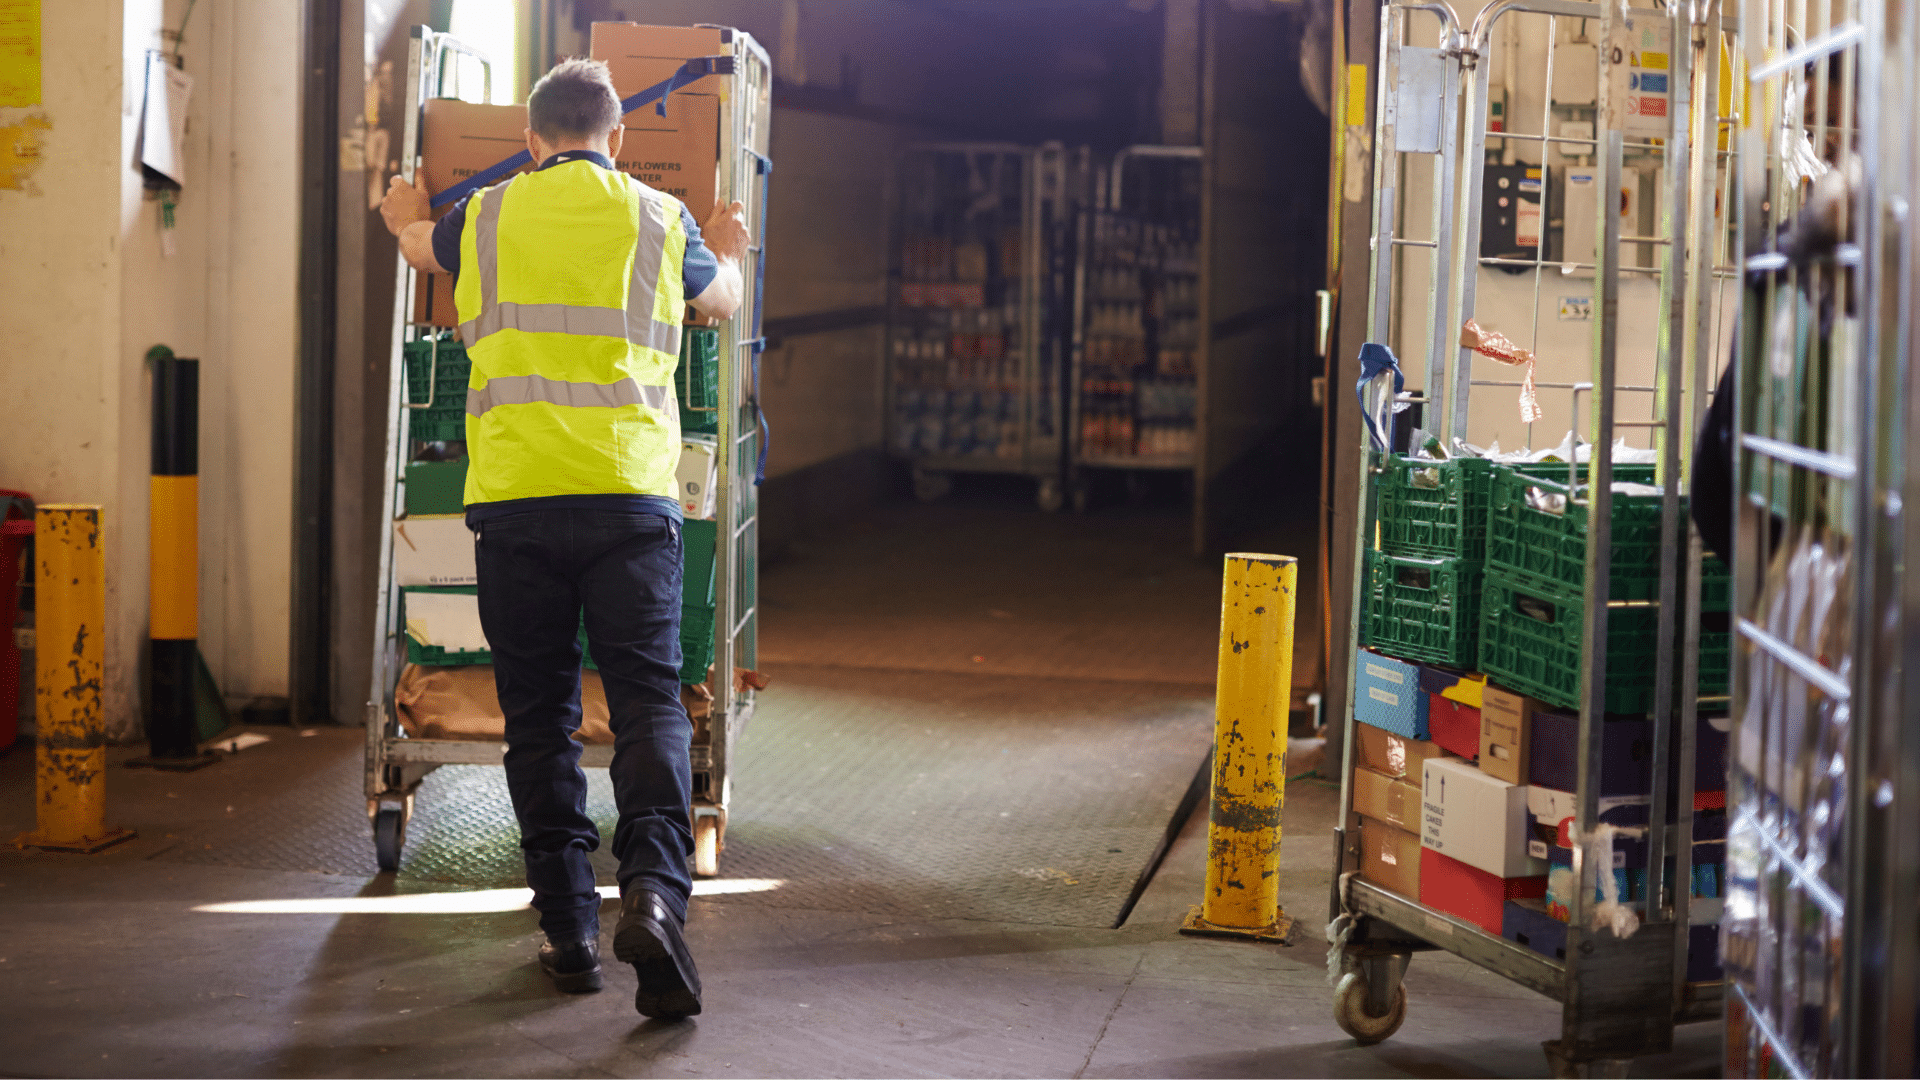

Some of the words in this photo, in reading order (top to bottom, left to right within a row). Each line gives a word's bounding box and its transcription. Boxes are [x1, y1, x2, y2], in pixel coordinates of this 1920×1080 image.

[631, 161, 682, 171] FLOWERS
[1423, 801, 1445, 817] FRAGILE
[1425, 813, 1443, 827] CAKES
[1428, 825, 1440, 837] THIS
[1423, 835, 1435, 846] WAY
[1435, 839, 1444, 849] UP
